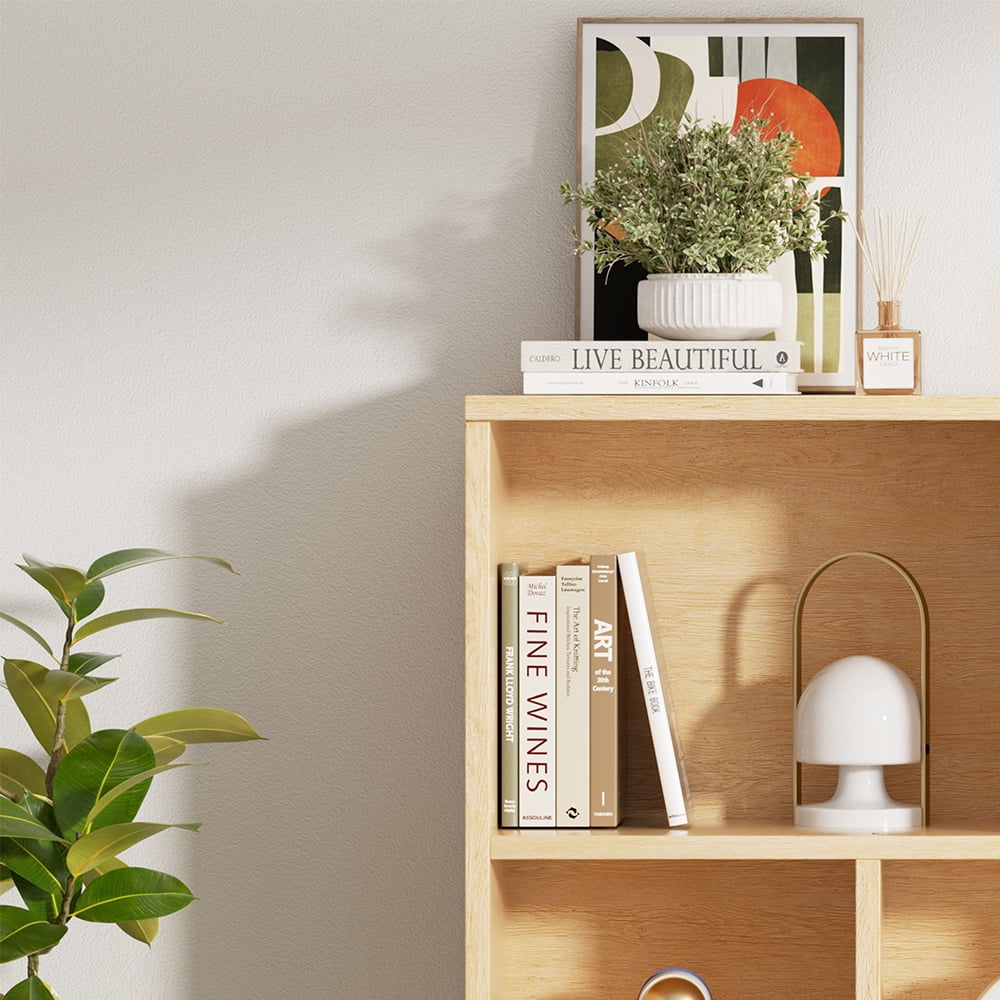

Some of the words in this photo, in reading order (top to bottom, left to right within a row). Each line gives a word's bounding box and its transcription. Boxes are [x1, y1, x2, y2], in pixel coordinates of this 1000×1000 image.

[572, 348, 622, 370] LIVE
[631, 347, 763, 371] BEAUTIFUL
[866, 351, 910, 361] WHITE
[634, 379, 679, 387] KINFOLK
[573, 606, 581, 620] The
[573, 621, 581, 633] Art
[526, 611, 548, 677] FINE
[573, 634, 581, 642] of
[594, 618, 613, 662] ART
[505, 646, 514, 675] FRANK
[571, 643, 581, 673] Knitting
[643, 666, 654, 679] THE
[505, 676, 514, 706] LLOYD
[592, 685, 614, 694] Century
[646, 680, 658, 696] BIKE
[649, 696, 661, 714] BOOK
[505, 706, 514, 743] WRIGHT
[526, 692, 548, 792] WINES
